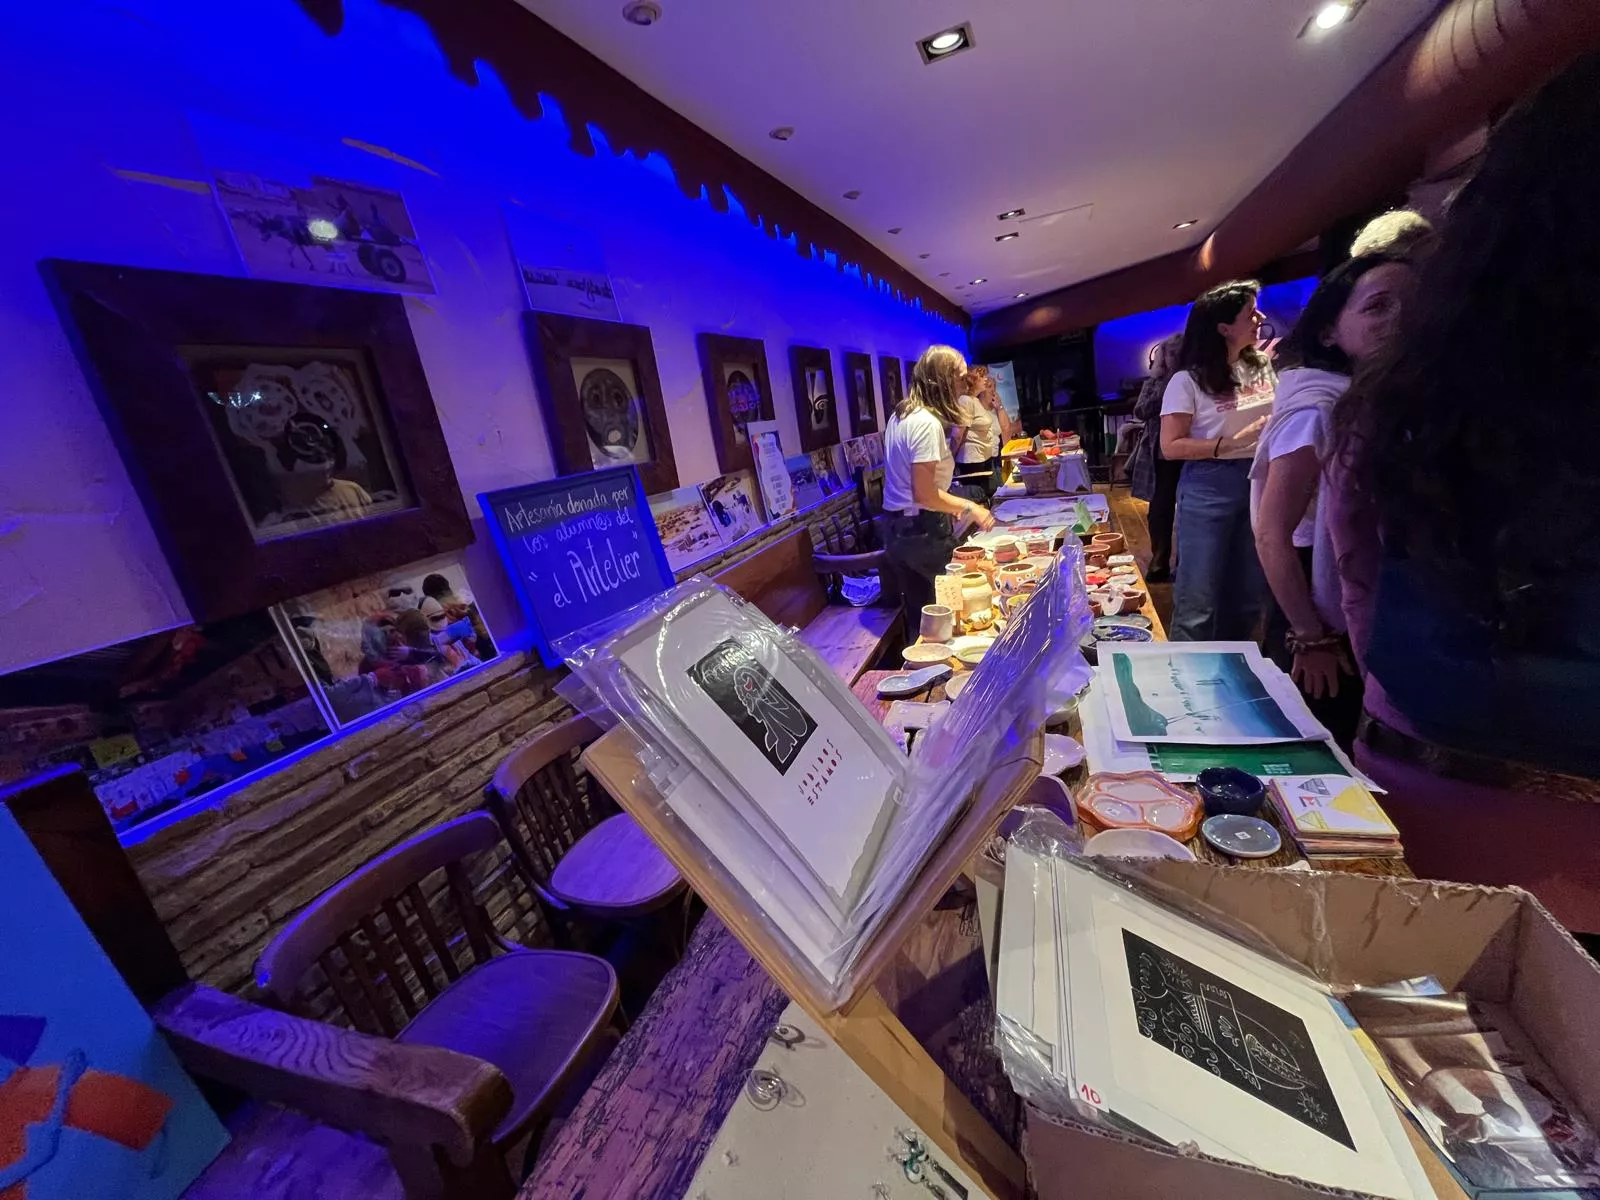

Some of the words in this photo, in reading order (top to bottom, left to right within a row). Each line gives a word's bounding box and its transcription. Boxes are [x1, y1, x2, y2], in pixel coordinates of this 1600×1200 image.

[505, 499, 564, 533] Artesanía
[567, 488, 607, 514] donada
[612, 486, 629, 509] por
[556, 514, 612, 542] alumn@s
[616, 507, 634, 526] del
[808, 750, 843, 805] ESTAMOS
[1081, 1084, 1101, 1104] 10
